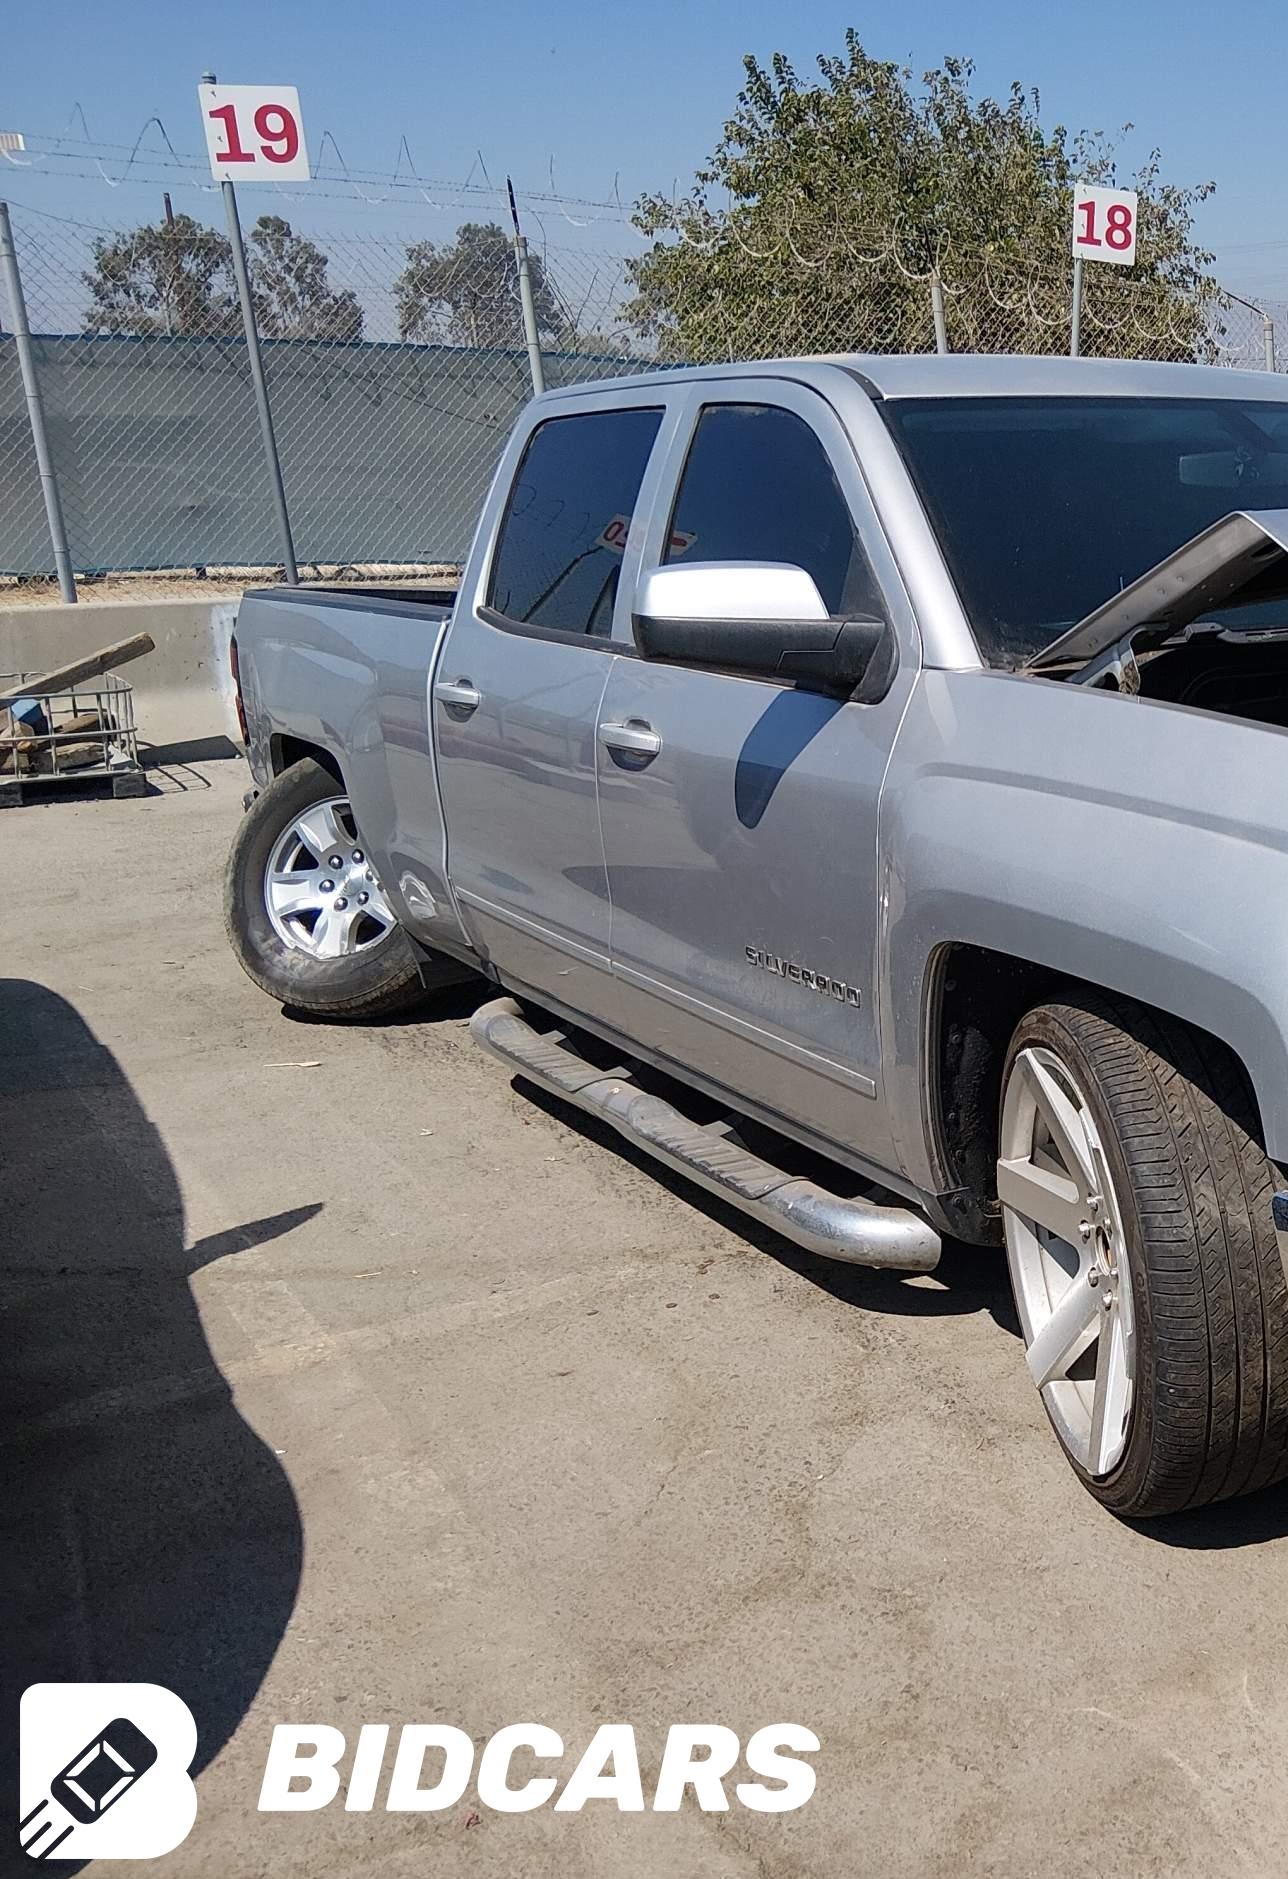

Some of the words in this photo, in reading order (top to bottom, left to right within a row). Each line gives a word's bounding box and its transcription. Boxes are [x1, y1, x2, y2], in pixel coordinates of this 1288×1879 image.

[208, 104, 299, 164] 19
[1077, 201, 1132, 250] 18
[745, 944, 861, 1008] SILVERADO
